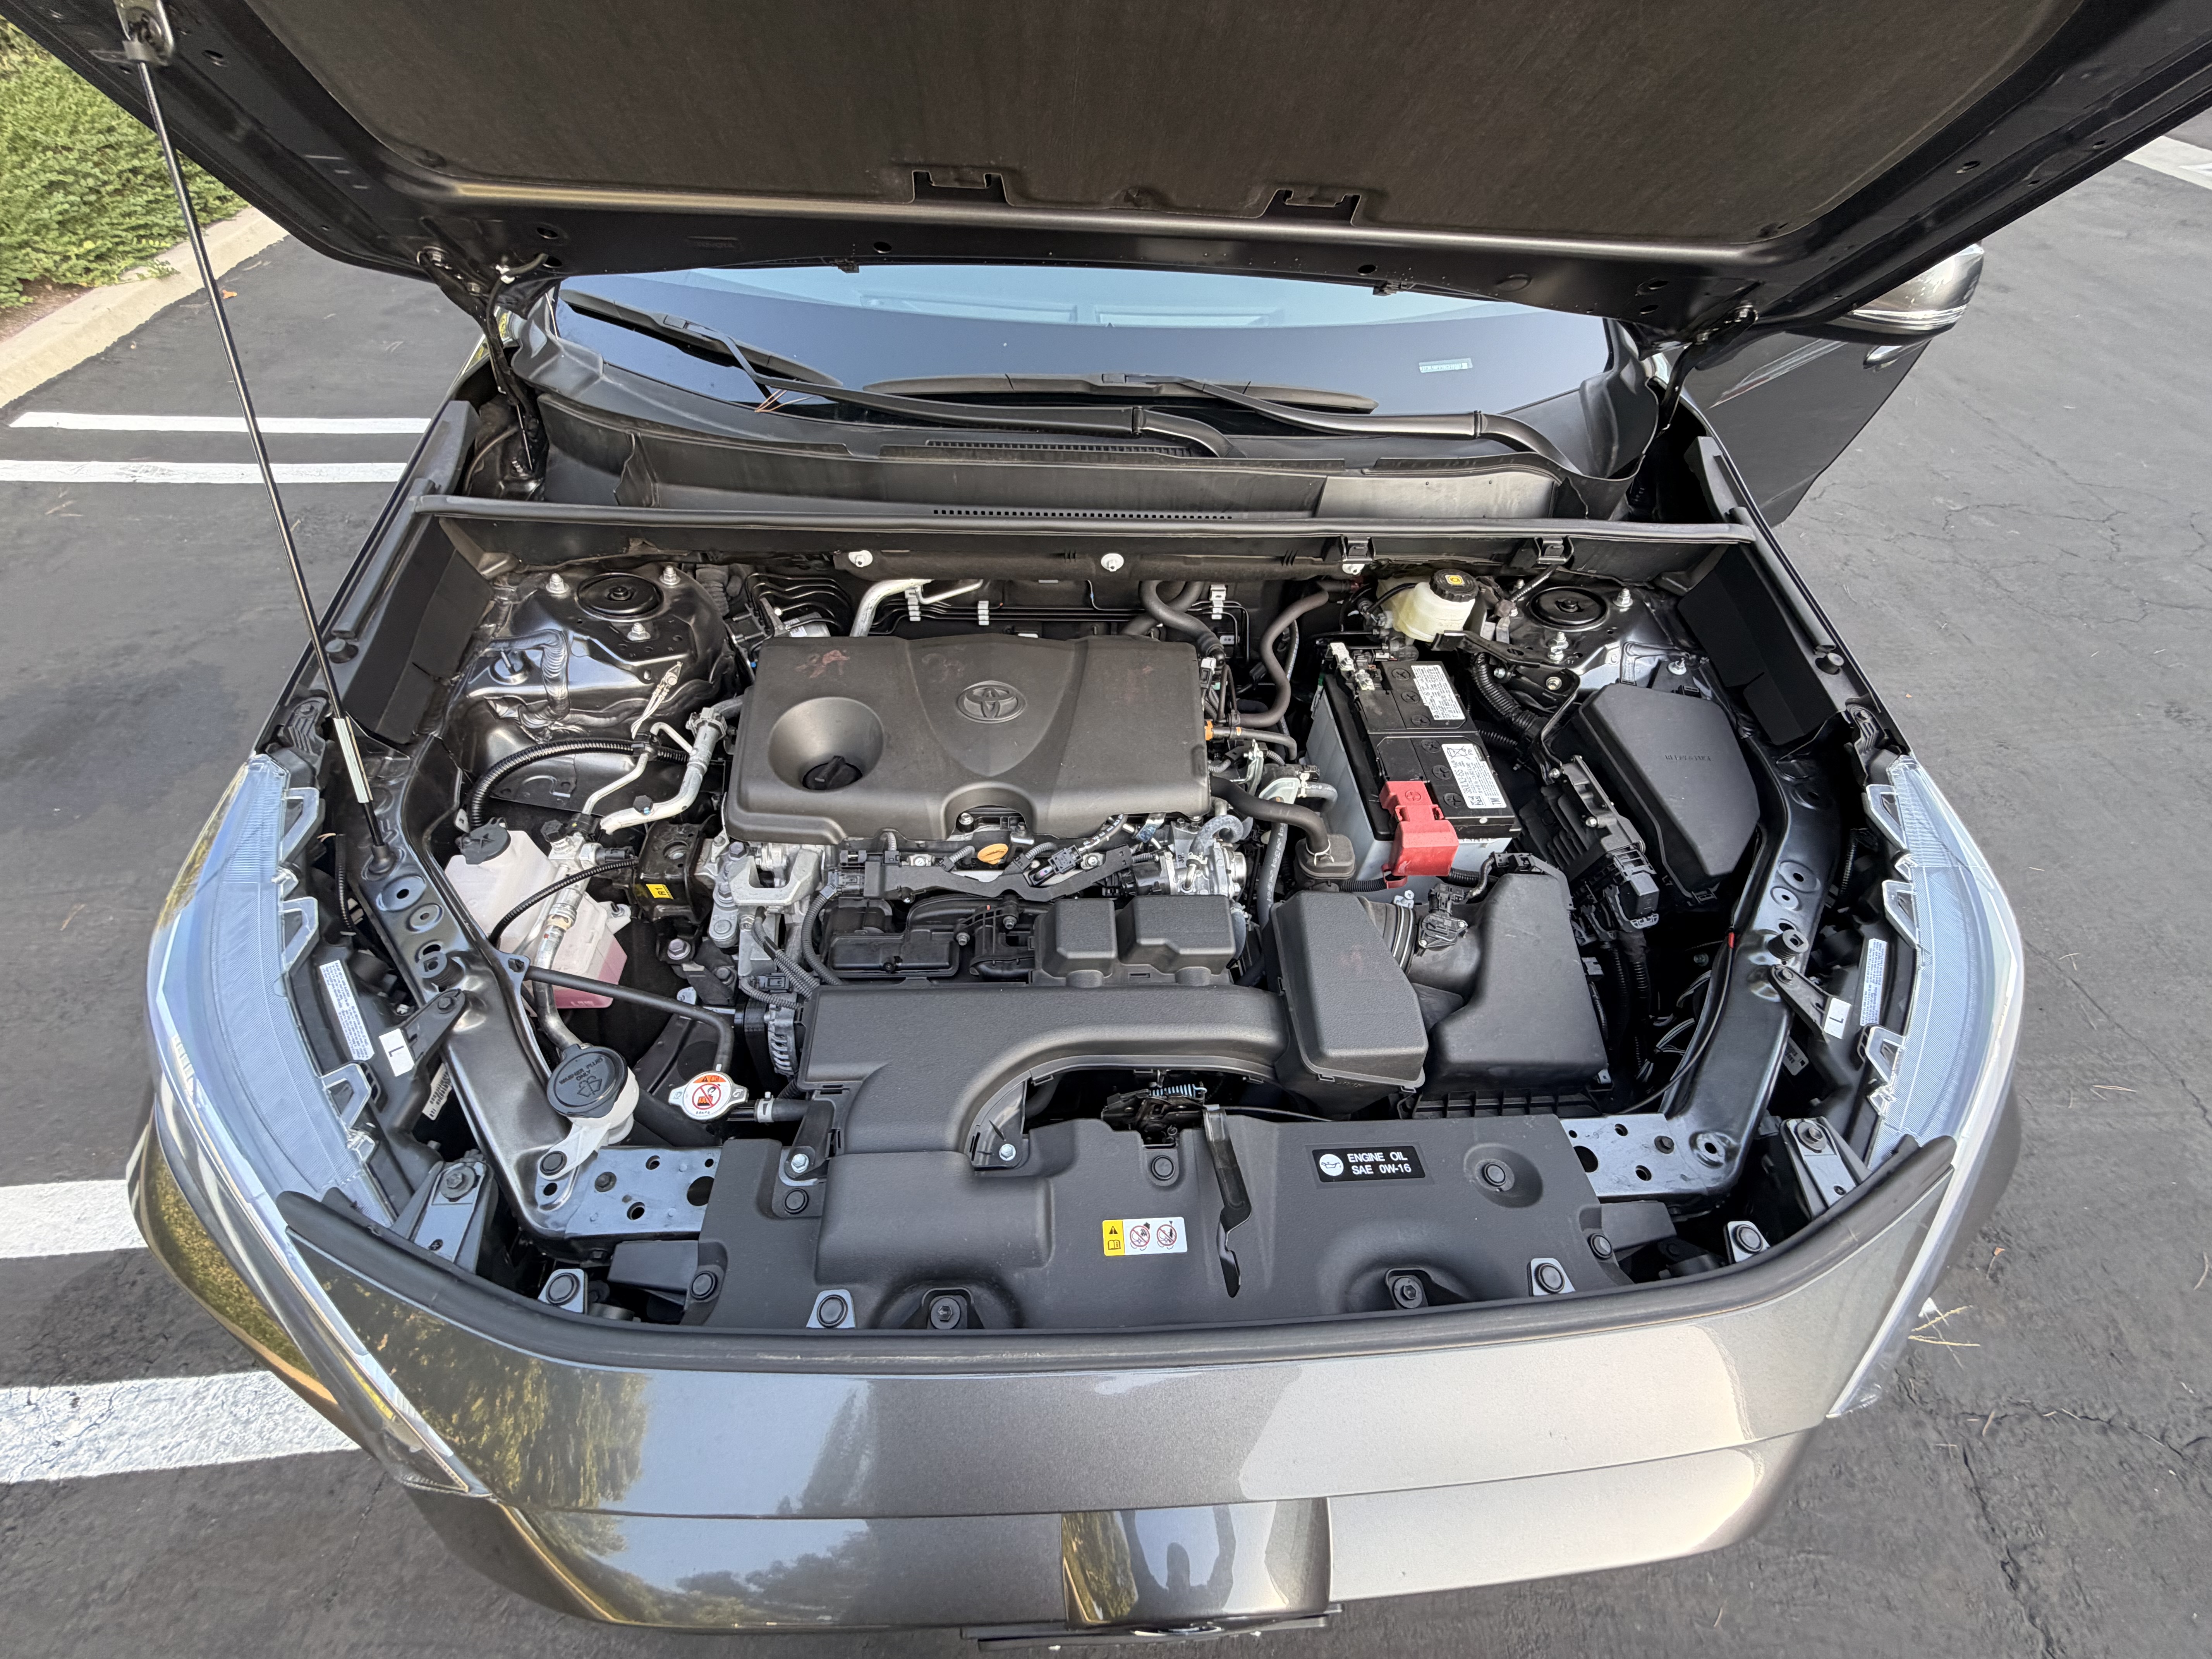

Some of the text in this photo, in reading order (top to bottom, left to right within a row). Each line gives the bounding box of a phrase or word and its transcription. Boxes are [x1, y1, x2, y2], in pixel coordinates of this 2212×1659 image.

[559, 1057, 604, 1085] WASHER FLUID
[576, 1070, 591, 1081] ONLY
[1346, 1151, 1408, 1163] ENGINE OIL
[1352, 1163, 1412, 1175] SAE 0W-16
